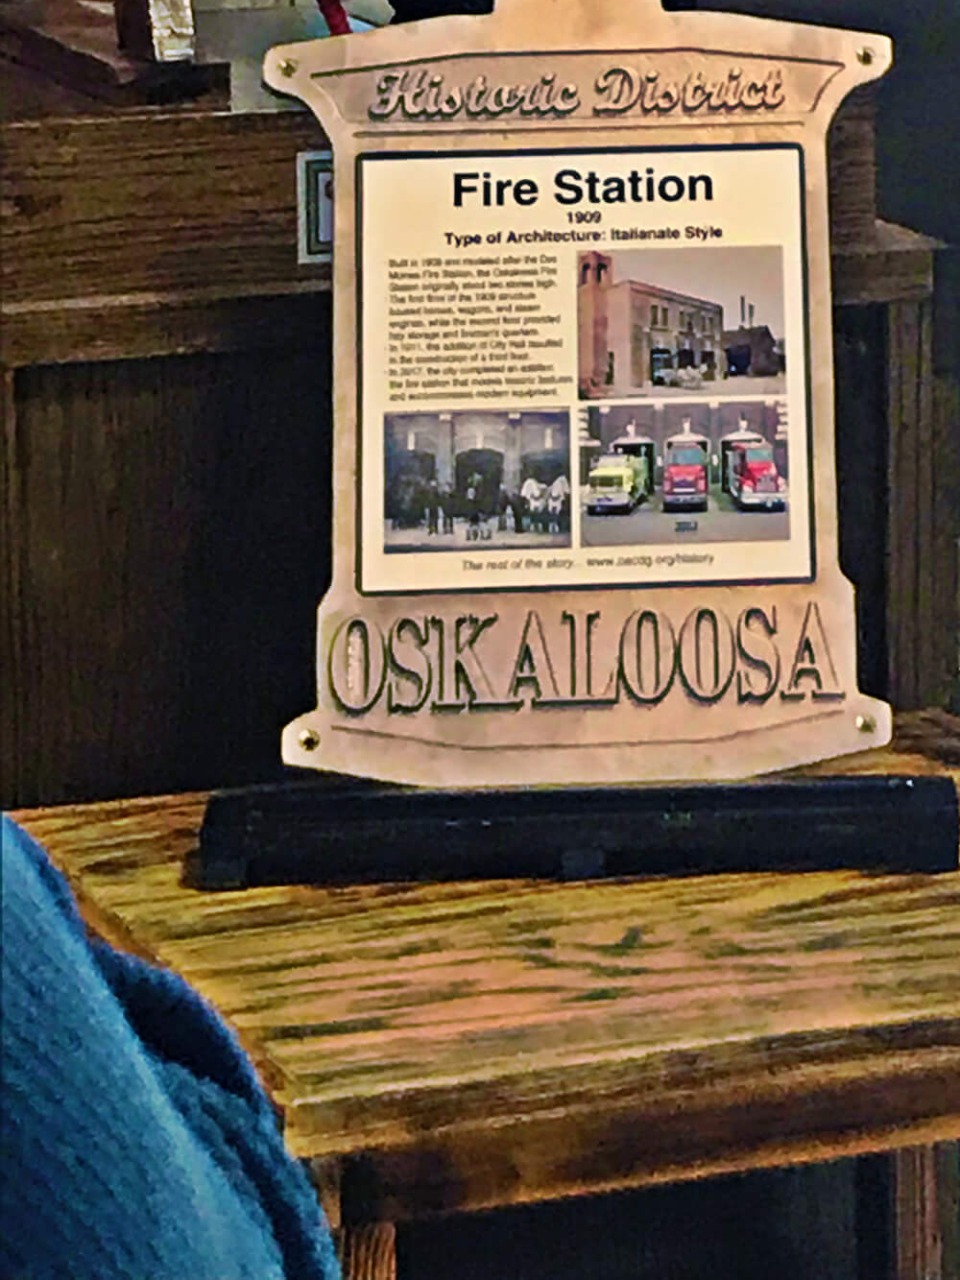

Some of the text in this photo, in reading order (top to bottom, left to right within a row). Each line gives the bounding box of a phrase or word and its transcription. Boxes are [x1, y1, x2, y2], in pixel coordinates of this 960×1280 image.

[368, 67, 786, 119] Historic District
[453, 168, 713, 206] Fire Station
[567, 211, 601, 224] 1909
[445, 226, 723, 248] Type of Architecture: Italianate Style
[327, 602, 846, 717] OSKALOOSA
